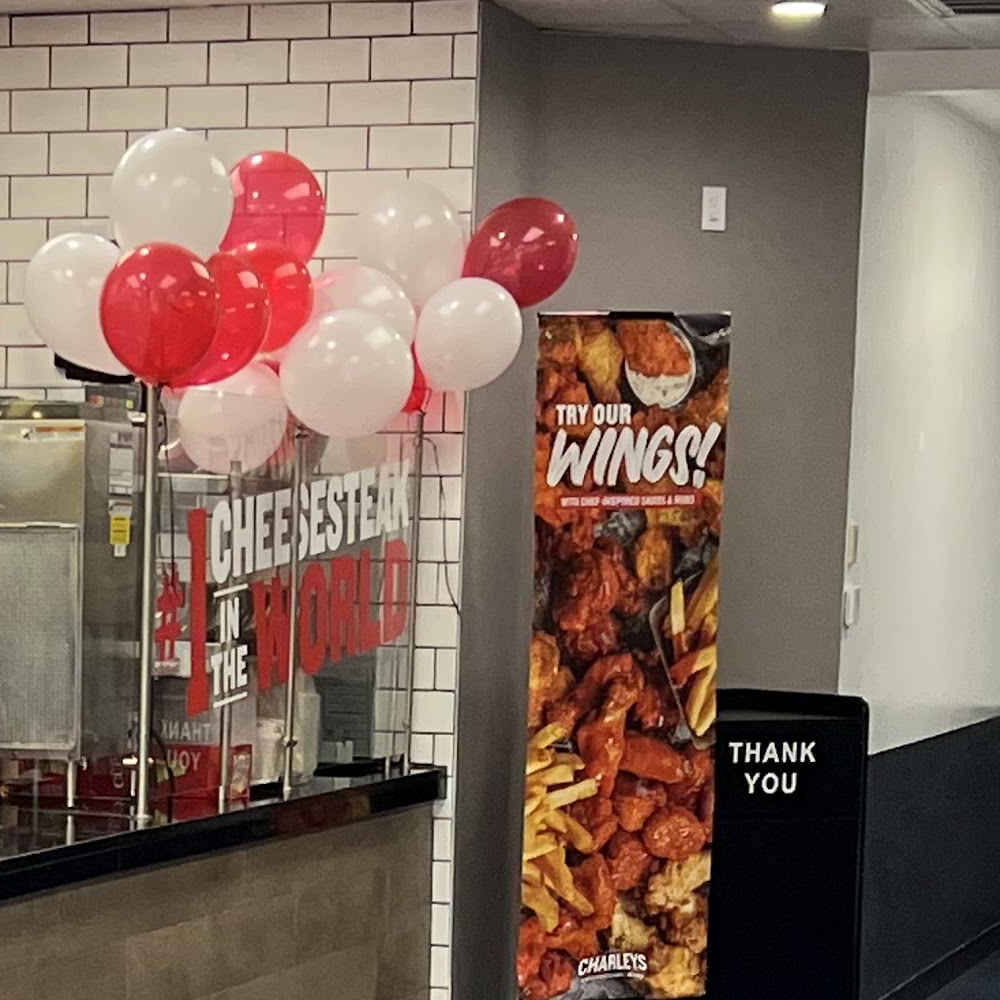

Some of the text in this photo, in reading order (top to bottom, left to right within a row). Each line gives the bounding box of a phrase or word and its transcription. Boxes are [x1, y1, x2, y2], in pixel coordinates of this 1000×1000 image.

[555, 403, 632, 426] TRY OUR
[546, 421, 722, 489] WINGS!
[211, 459, 410, 584] CHEESESTEAK
[218, 596, 241, 644] IN
[252, 537, 410, 692] WORLD
[210, 643, 249, 697] THE
[728, 740, 817, 764] THANK
[743, 772, 798, 795] YOU
[577, 952, 648, 977] CHARLEYS
